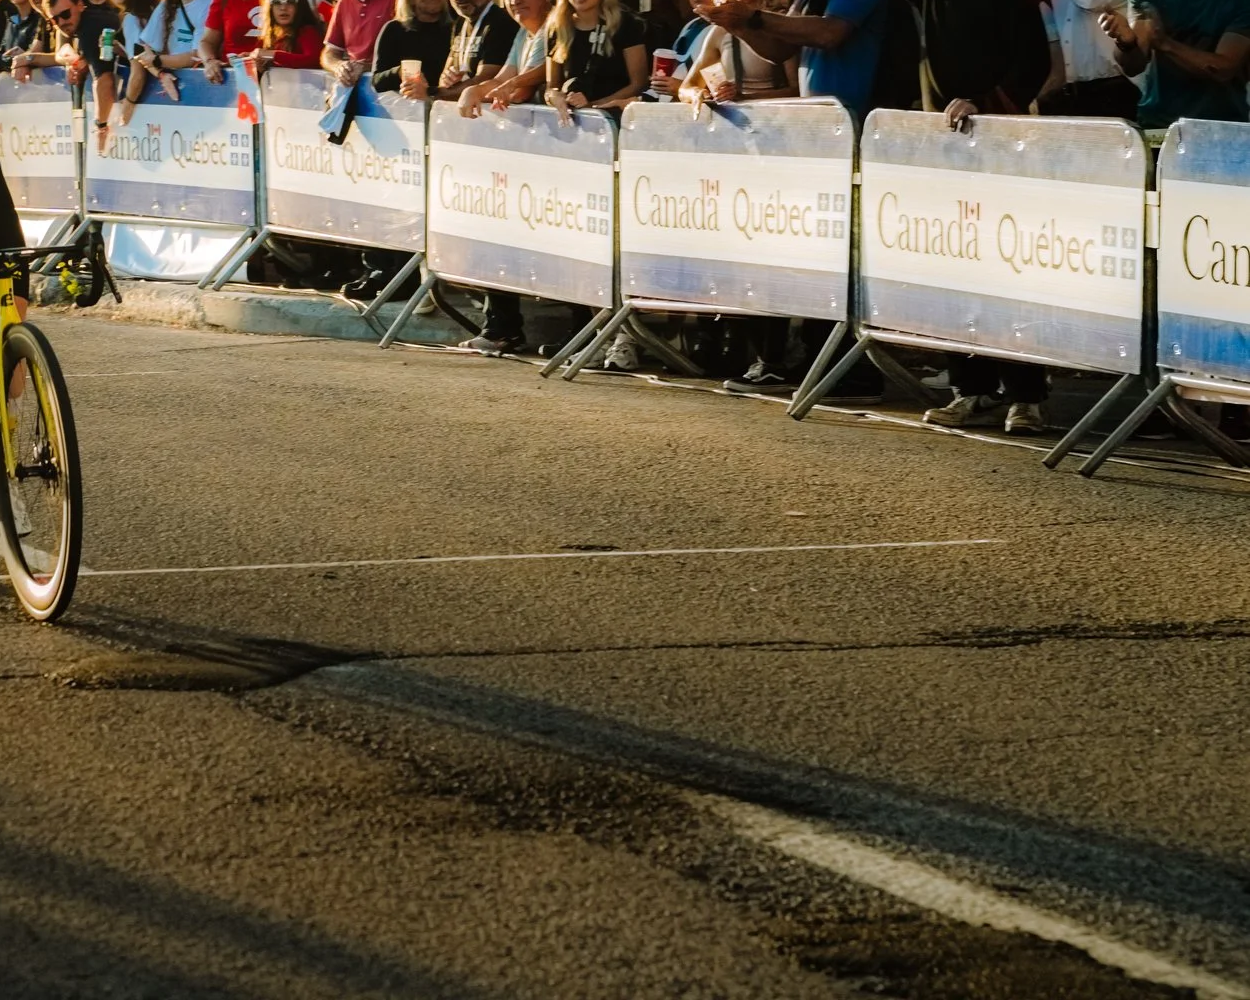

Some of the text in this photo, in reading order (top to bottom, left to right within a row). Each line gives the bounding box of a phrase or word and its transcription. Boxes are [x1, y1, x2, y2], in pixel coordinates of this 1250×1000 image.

[171, 129, 228, 168] Québec
[439, 164, 583, 231] Canada Québec
[633, 175, 812, 240] Canada Québec
[877, 191, 1096, 274] Canada Québec
